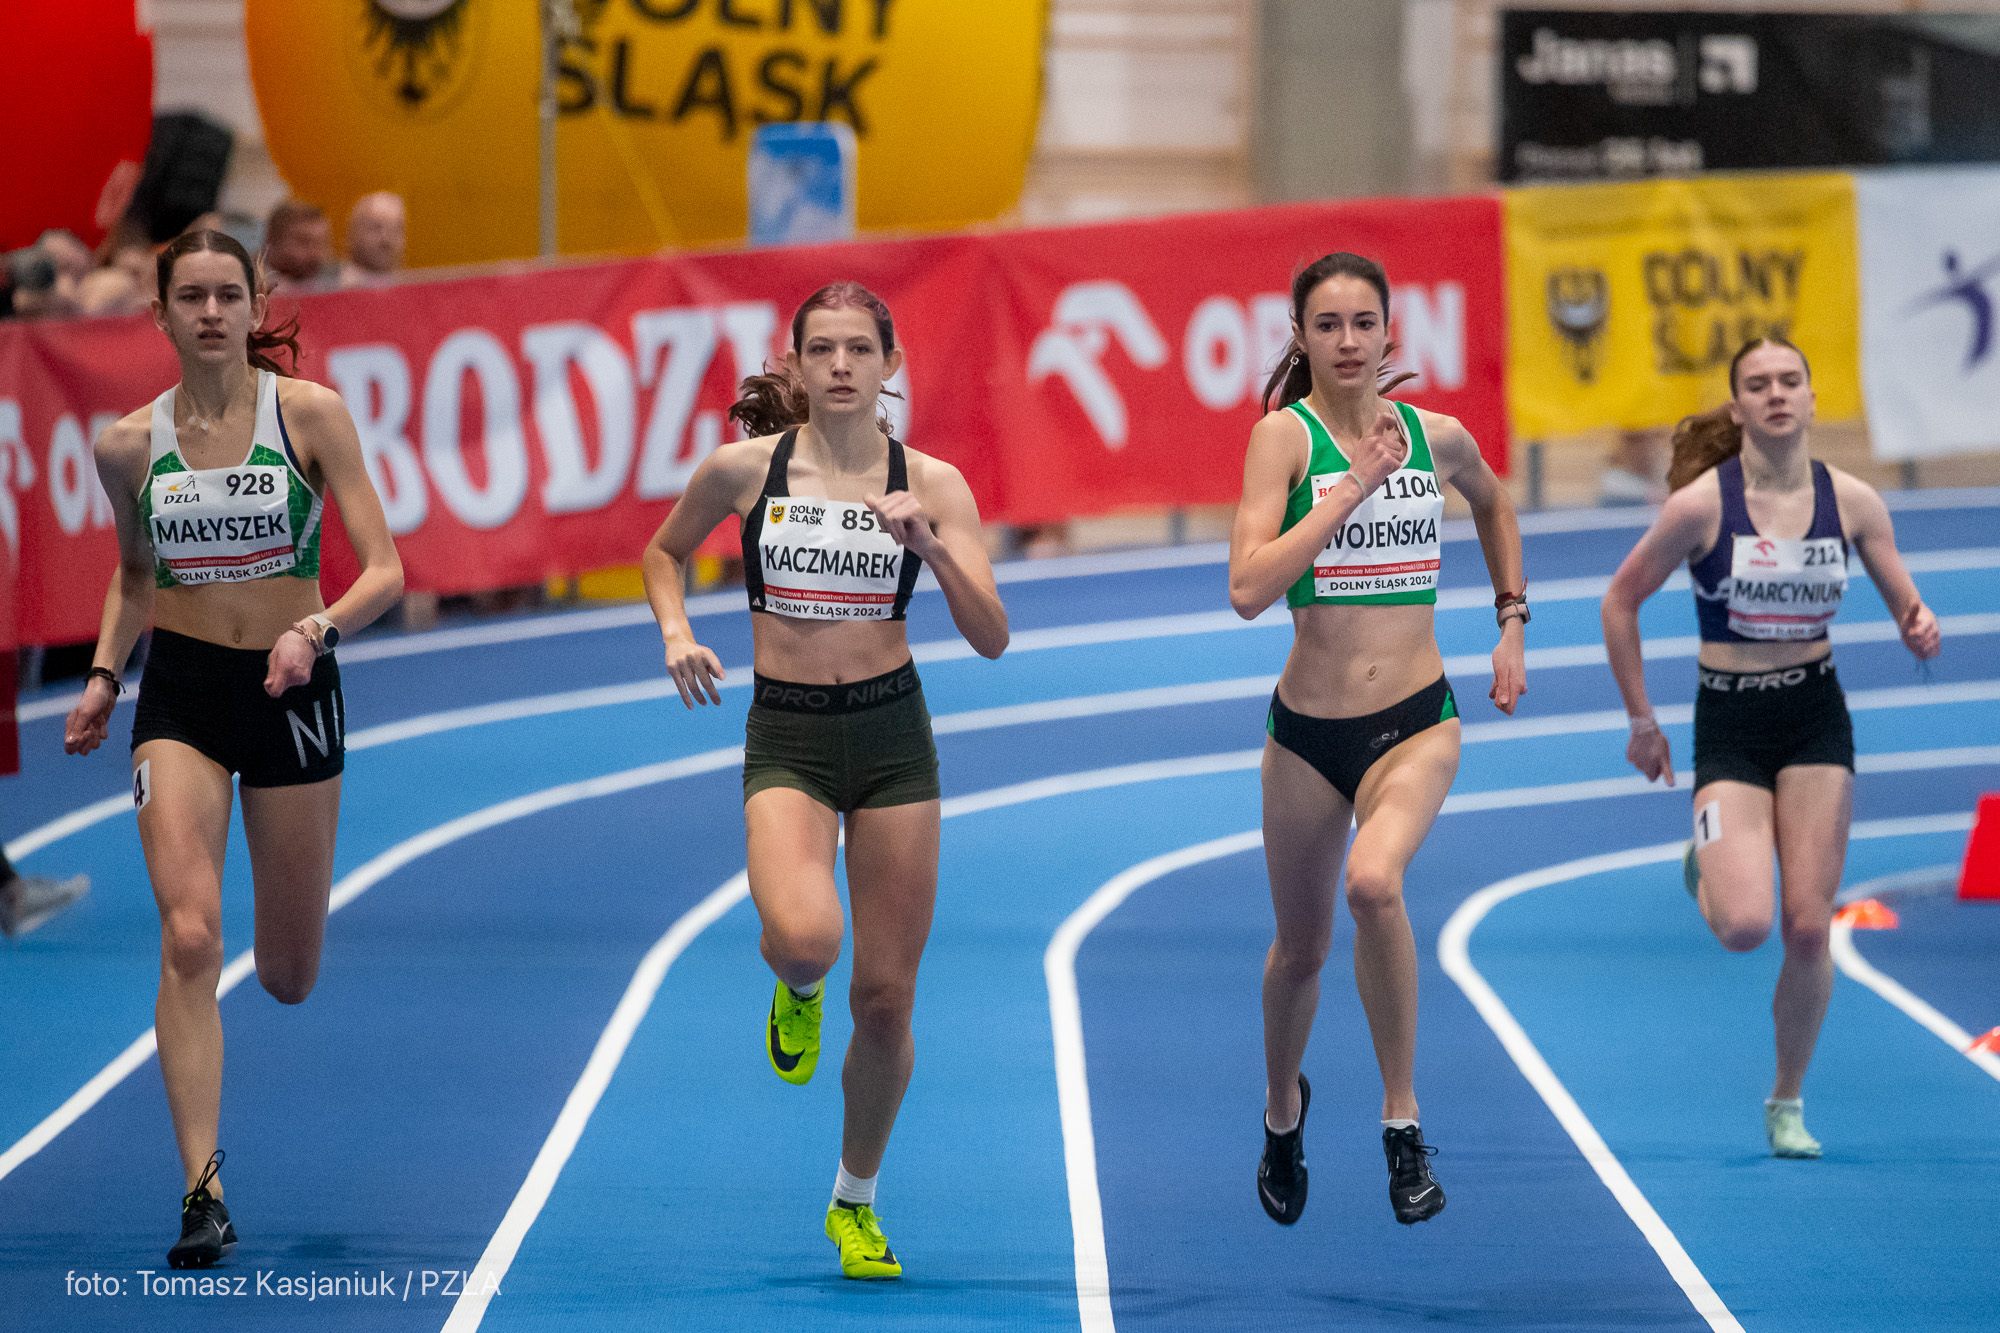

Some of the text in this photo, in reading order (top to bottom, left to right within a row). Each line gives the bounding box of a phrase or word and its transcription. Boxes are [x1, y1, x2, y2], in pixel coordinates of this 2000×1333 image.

[226, 473, 275, 497] 928
[1380, 476, 1438, 500] 1104
[163, 493, 200, 505] DZLA
[790, 505, 826, 517] DOLNY
[155, 512, 287, 545] MAŁYSZEK
[788, 513, 823, 526] ŚLĄSK
[841, 509, 891, 533] 85
[213, 567, 251, 581] ŚLĄSK
[253, 559, 282, 575] 2024
[764, 544, 898, 580] KACZMAREK
[1318, 568, 1336, 576] PZLA
[1336, 567, 1363, 576] Halowe
[1364, 565, 1400, 575] Mistrzostwa
[1330, 574, 1432, 591] DOLNY ŚLĄSK 2024
[779, 590, 802, 599] Halowe
[802, 591, 844, 602] Mistrzostwa
[775, 600, 882, 618] DOLNY ŚLĄSK 2024
[760, 685, 831, 708] PRO
[846, 669, 914, 707] NIKE
[1737, 667, 1807, 692] PRO
[286, 689, 341, 769] NI
[133, 768, 145, 808] 4
[1699, 809, 1710, 841] 1
